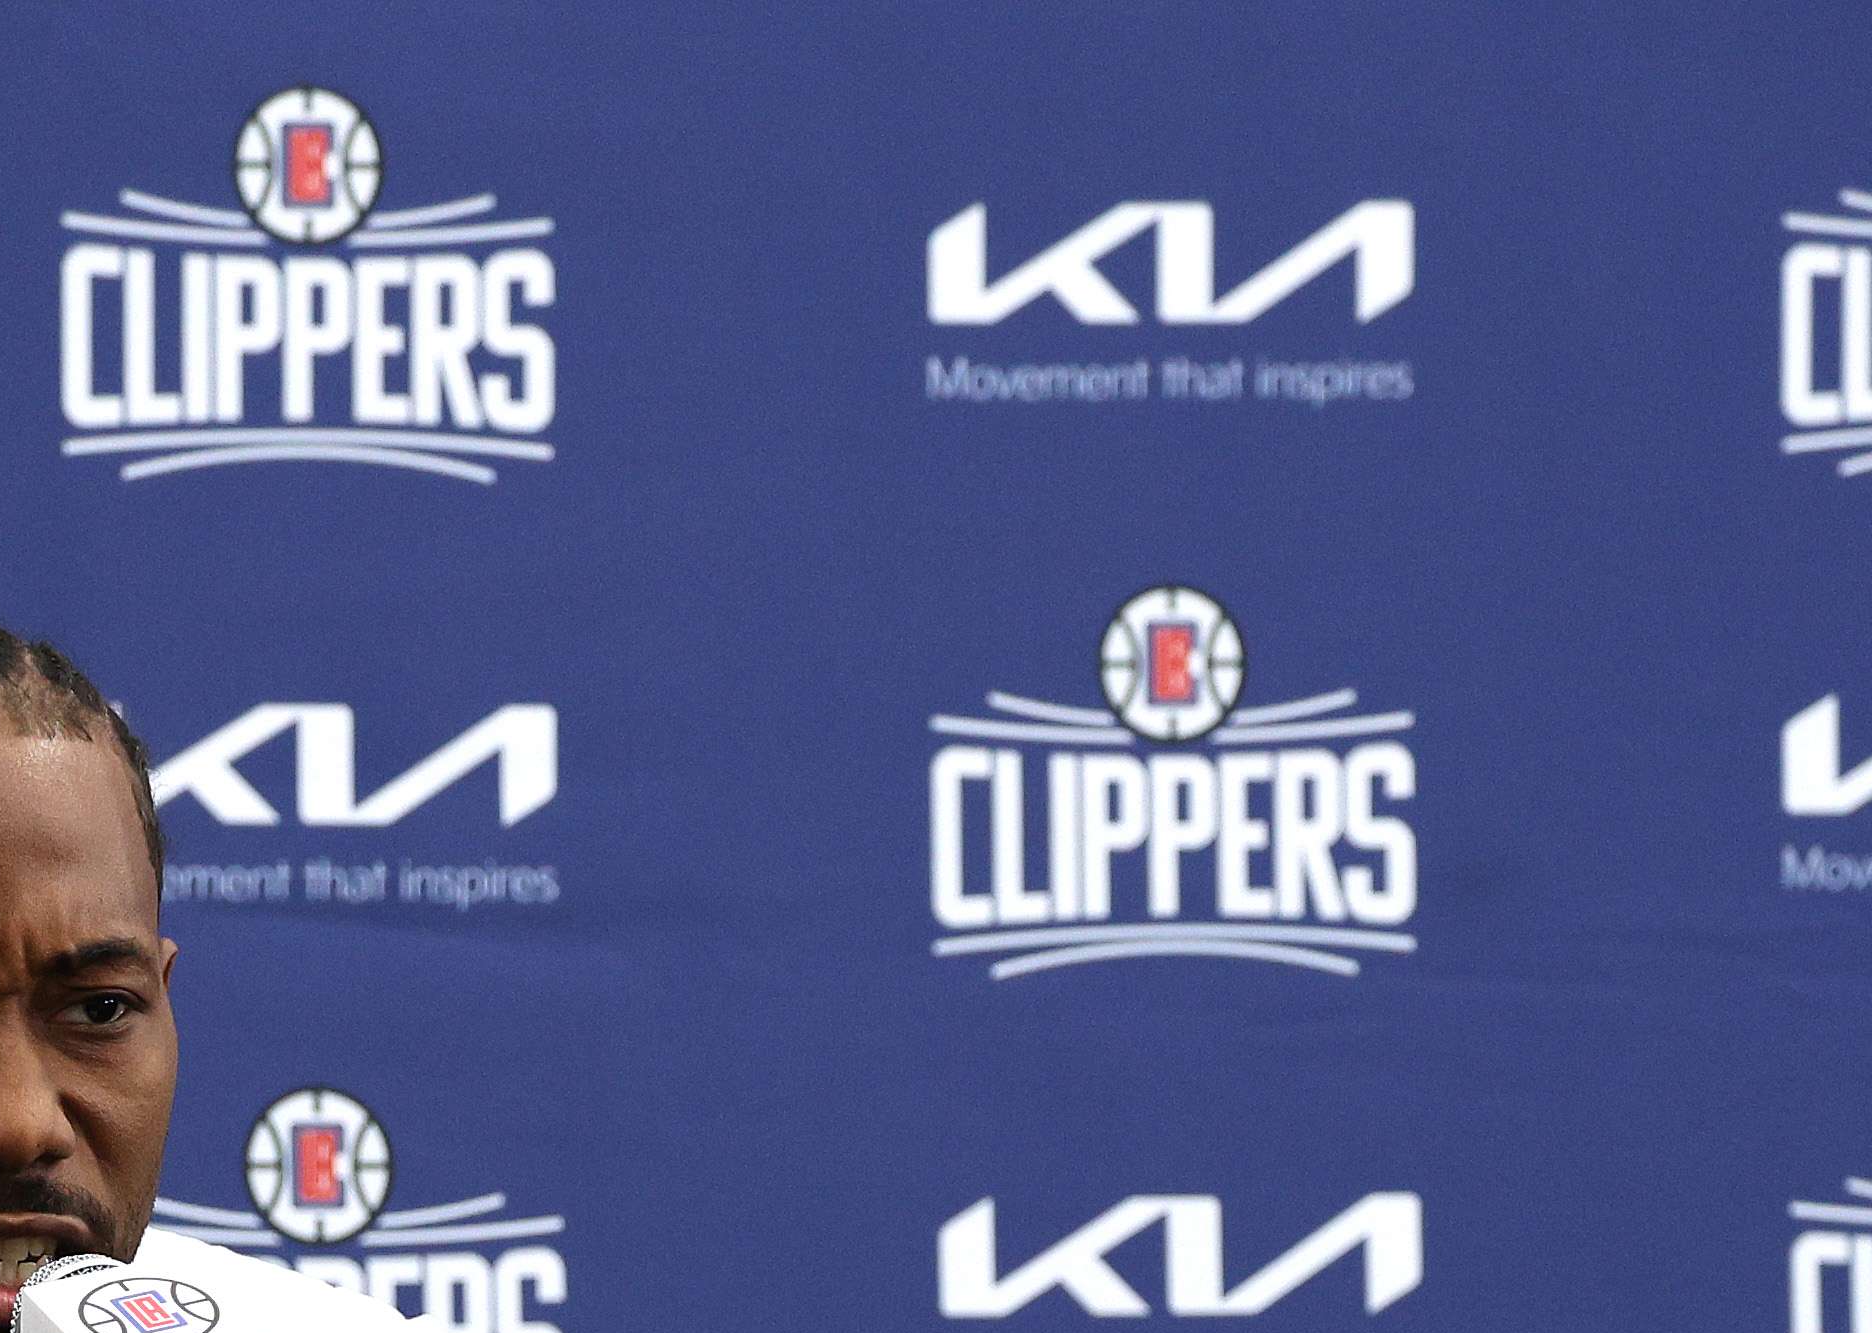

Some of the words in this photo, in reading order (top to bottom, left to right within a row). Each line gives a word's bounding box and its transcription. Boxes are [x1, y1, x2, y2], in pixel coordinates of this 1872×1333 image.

[927, 199, 1415, 325] KIA
[61, 244, 555, 432] CLIPPERS
[925, 356, 1151, 402] Movement
[1159, 357, 1244, 400] that
[1255, 359, 1414, 407] inspires
[166, 860, 292, 903] ement
[303, 858, 388, 902] that
[400, 859, 559, 910] inspires
[930, 742, 1417, 928] CLIPPERS
[937, 1192, 1423, 1318] KIA
